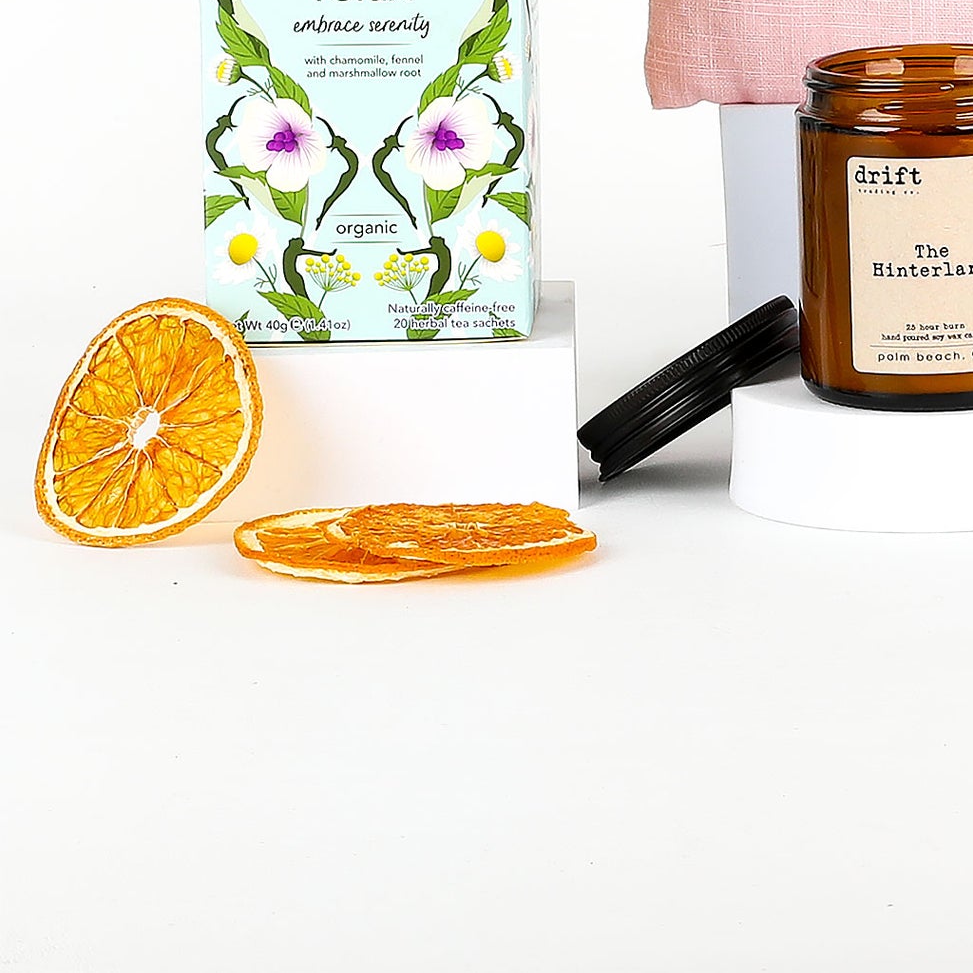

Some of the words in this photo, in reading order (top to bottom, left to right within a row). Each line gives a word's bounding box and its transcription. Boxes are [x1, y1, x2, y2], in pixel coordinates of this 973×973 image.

[293, 14, 365, 34] embrace
[368, 12, 431, 39] serenity
[304, 55, 327, 65] with
[329, 55, 389, 66] chamomile,
[391, 54, 424, 65] fennel
[306, 68, 326, 78] and
[328, 68, 398, 78] marshmallow
[400, 68, 422, 78] root
[854, 165, 922, 185] drift
[336, 220, 398, 239] organic
[915, 244, 949, 258] The
[388, 302, 440, 316] Naturally
[442, 301, 516, 313] caffeine-free
[245, 320, 262, 331] Wt
[266, 319, 288, 333] 40g
[305, 319, 351, 333] (1.41oz)
[394, 318, 408, 329] 20
[411, 318, 447, 328] herbal
[451, 320, 470, 328] tea
[473, 318, 516, 328] sachets
[919, 323, 940, 331] hour
[943, 322, 965, 331] burn
[881, 333, 901, 341] hand
[903, 333, 930, 342] poured
[932, 333, 945, 342] soy
[947, 332, 962, 340] wax
[877, 351, 911, 363] palm
